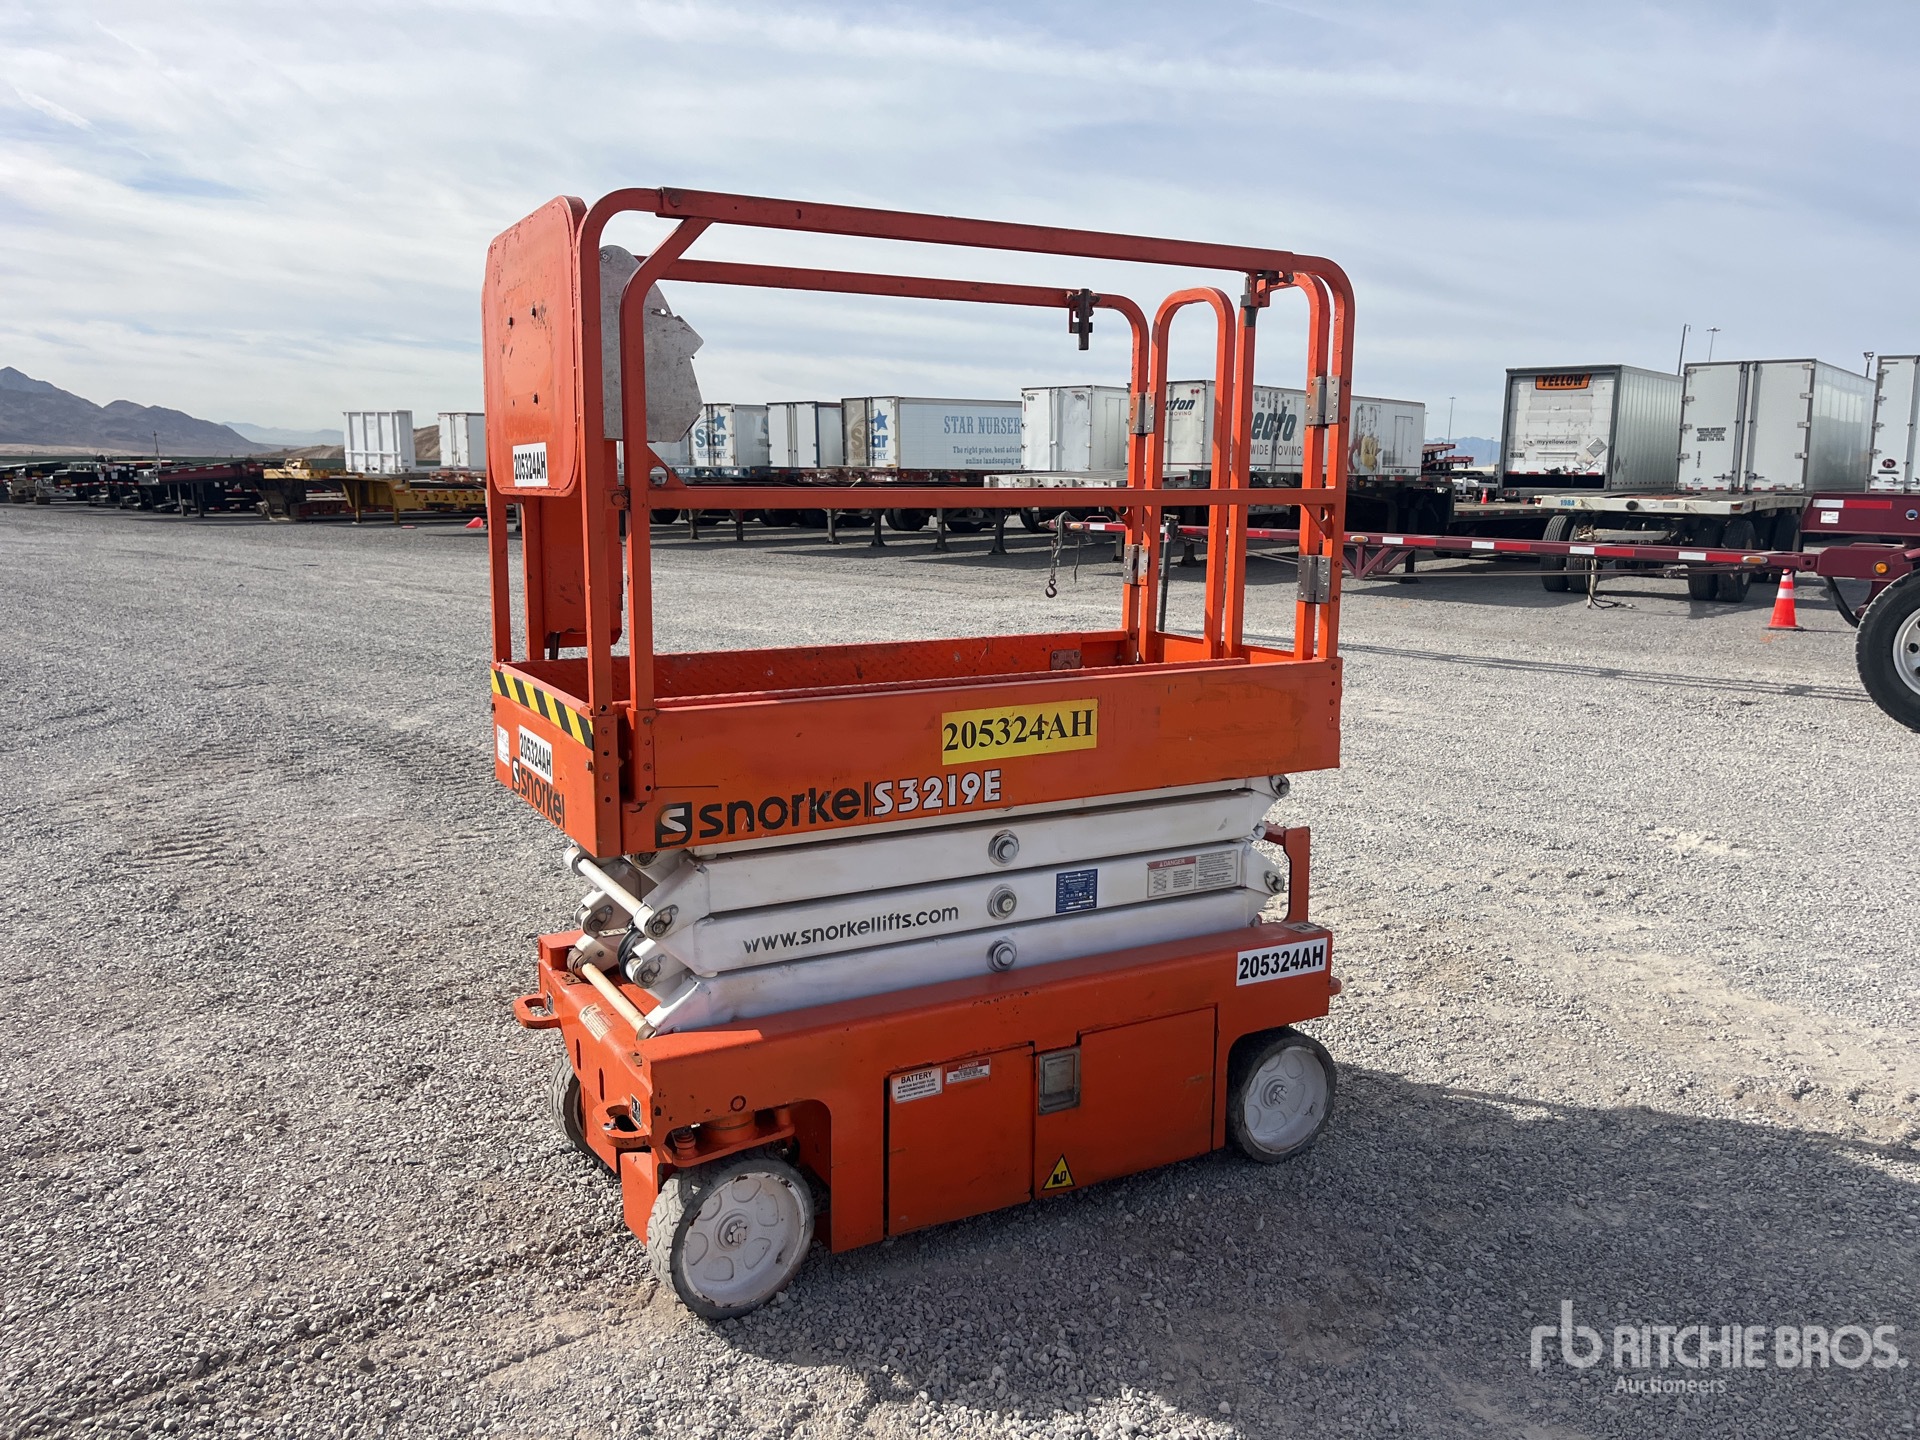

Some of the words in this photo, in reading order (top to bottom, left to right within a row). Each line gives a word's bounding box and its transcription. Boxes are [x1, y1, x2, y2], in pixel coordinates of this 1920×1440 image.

[1542, 375, 1586, 387] YELLOW
[944, 416, 974, 434] STAR
[977, 416, 1022, 434] NURSER
[514, 451, 547, 480] 205324AH
[943, 709, 1094, 751] 205324AH
[519, 732, 552, 777] 205324AH
[872, 769, 1001, 817] S3219E
[1163, 858, 1186, 867] DANGER
[743, 906, 959, 954] www.snorkellifts.com
[1238, 944, 1324, 980] 205324AH
[901, 1070, 933, 1084] BATTERY
